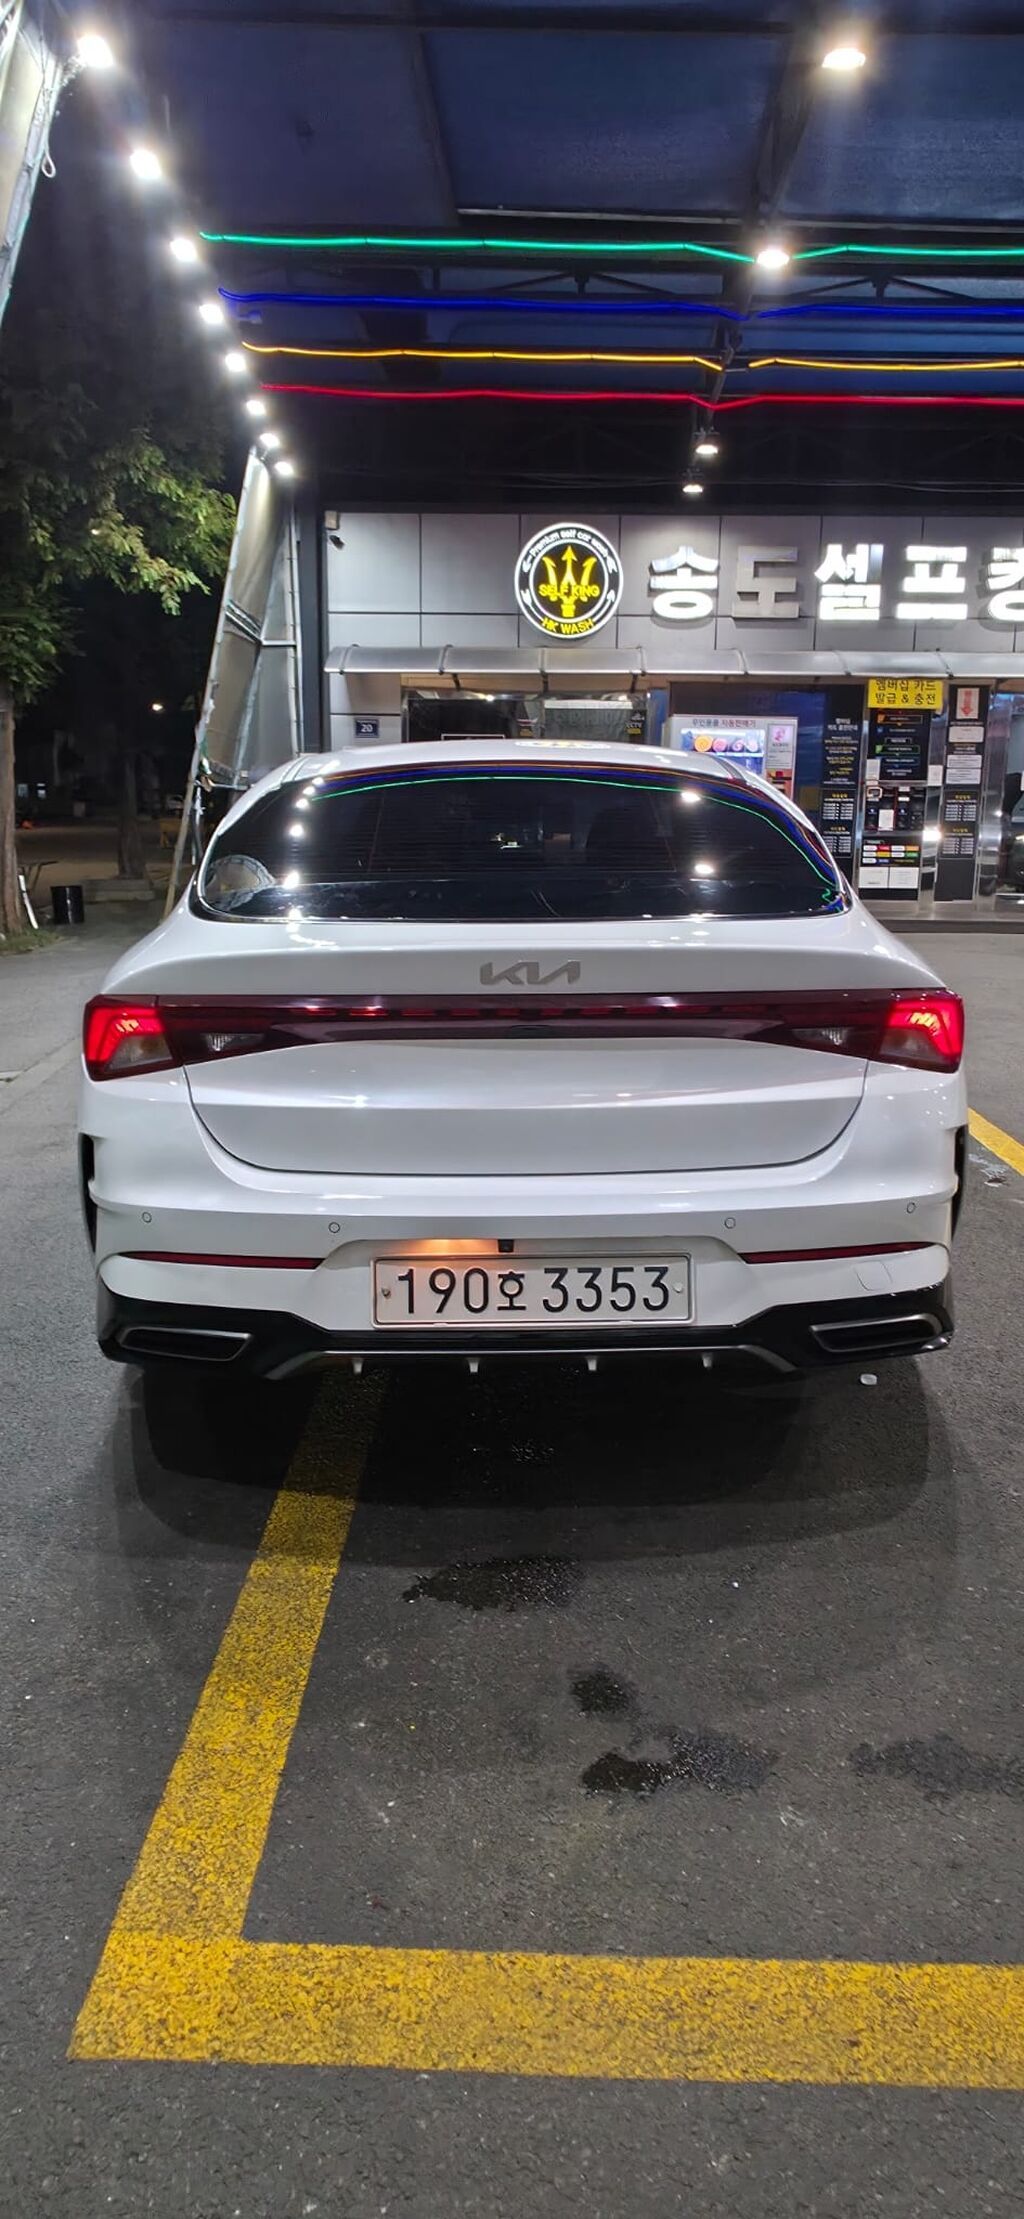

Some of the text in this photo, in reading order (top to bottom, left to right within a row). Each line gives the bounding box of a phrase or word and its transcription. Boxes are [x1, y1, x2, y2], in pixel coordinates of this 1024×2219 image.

[530, 531, 560, 556] Premium
[560, 529, 577, 539] self
[577, 531, 591, 542] car
[538, 584, 600, 597] SELF KING
[542, 617, 594, 634] HK WASH
[914, 679, 936, 691] 카드
[876, 692, 936, 705] 발급 & 충전
[361, 724, 373, 732] 20
[480, 960, 581, 985] KIA
[397, 1266, 669, 1314] 190호 3353
